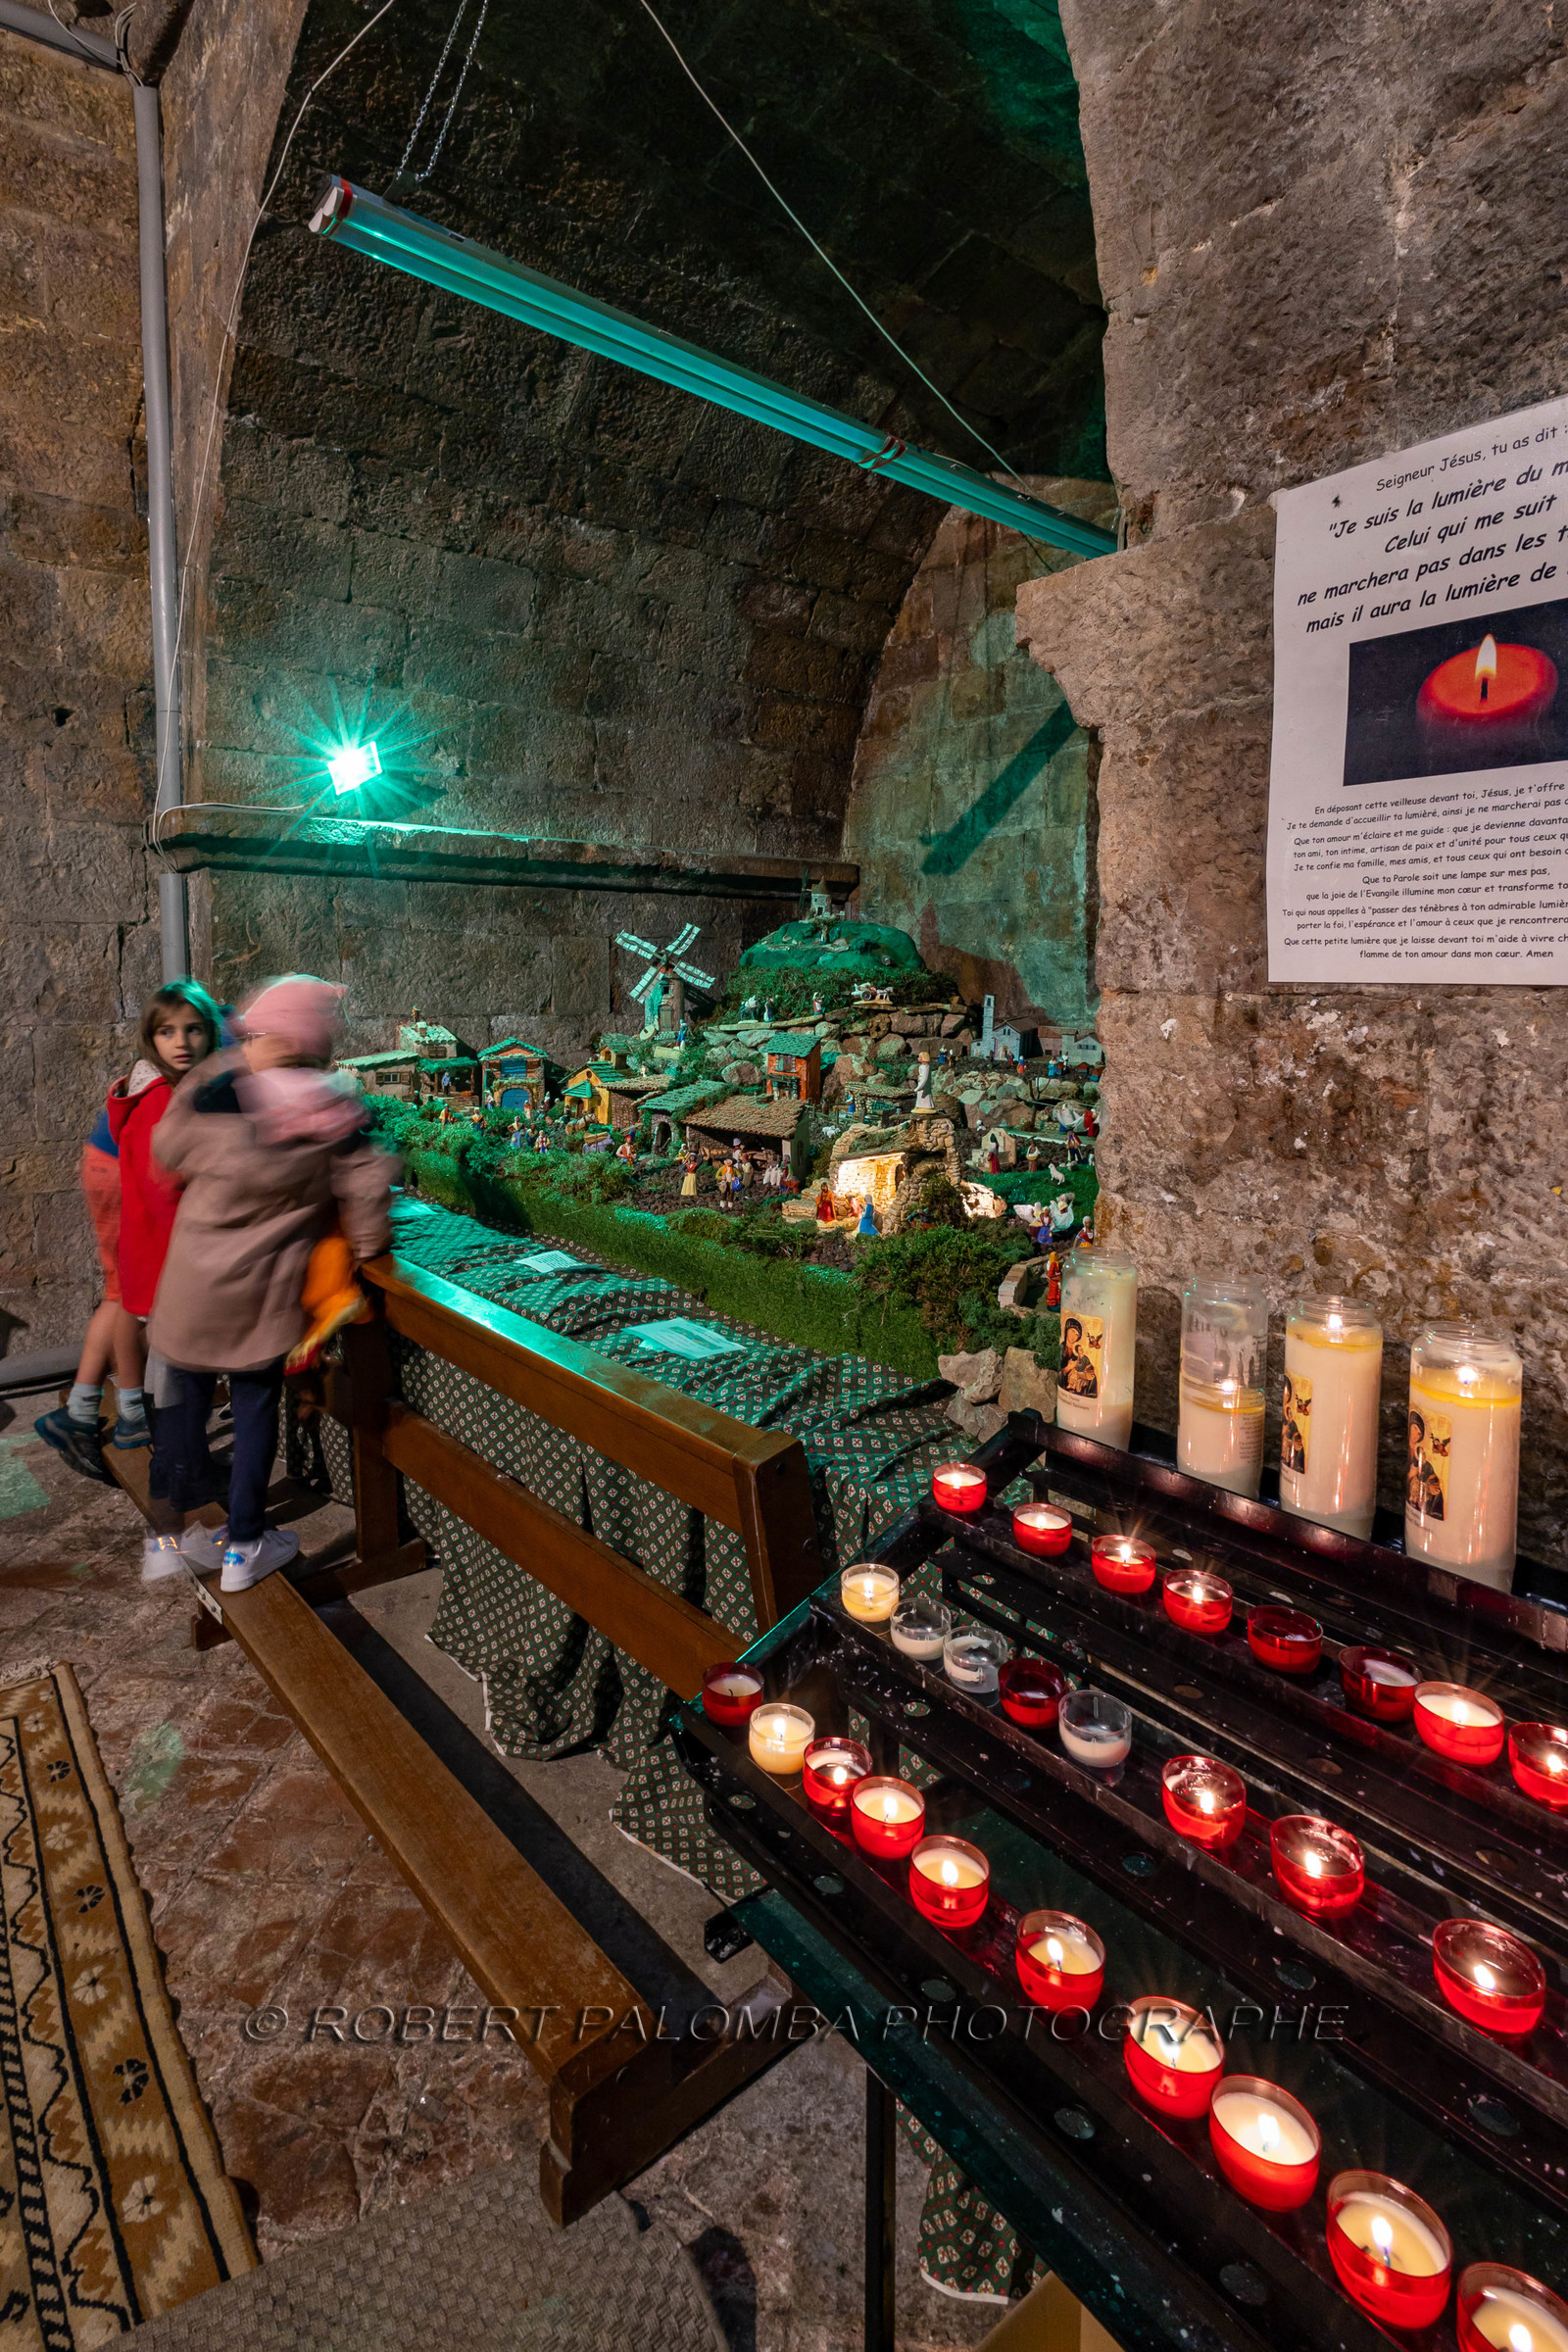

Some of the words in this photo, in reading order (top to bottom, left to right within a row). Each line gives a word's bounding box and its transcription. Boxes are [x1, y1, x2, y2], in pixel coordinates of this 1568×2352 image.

[1376, 465, 1435, 492] Seigneur
[1439, 450, 1487, 472] Jésus,
[1491, 443, 1508, 456] tu
[1512, 435, 1530, 450] as
[1535, 426, 1558, 443] dit
[1329, 519, 1357, 539] "Je
[1363, 507, 1400, 530] suis
[1405, 498, 1424, 517] la
[1431, 477, 1507, 511] lumière
[1515, 464, 1544, 486] du
[1384, 525, 1432, 554] Celui
[1437, 520, 1467, 545] qui
[1474, 511, 1505, 530] me
[1512, 493, 1558, 520] suit
[1297, 591, 1318, 607] ne
[1323, 567, 1410, 600] marchera
[1414, 557, 1451, 582] pas
[1458, 543, 1507, 566] dans
[1514, 532, 1547, 553] les
[1305, 612, 1346, 633] mais
[1351, 604, 1364, 623] il
[1369, 599, 1412, 619] aura
[1419, 589, 1438, 608] la
[1445, 573, 1521, 603] lumière
[1530, 562, 1557, 583] de
[1314, 806, 1325, 815] En
[1326, 803, 1363, 814] déposant
[1364, 801, 1388, 810] cette
[1390, 797, 1427, 808] veilleuse
[1429, 793, 1460, 804] devant
[1462, 792, 1478, 801] toi,
[1481, 788, 1512, 799] Jésus,
[1513, 786, 1525, 798] je
[1527, 782, 1565, 794] t'offre
[1286, 822, 1297, 831] Je
[1308, 817, 1344, 829] demande
[1345, 813, 1392, 825] d'accueillir
[1404, 808, 1440, 820] lumière,
[1442, 808, 1463, 816] ainsi
[1464, 807, 1476, 817] je
[1492, 799, 1542, 812] marcherai
[1544, 799, 1562, 809] pas
[1294, 837, 1310, 847] Que
[1326, 835, 1351, 844] amour
[1352, 831, 1392, 841] m'éclaire
[1393, 829, 1403, 838] et
[1420, 825, 1445, 838] guide
[1451, 825, 1469, 835] que
[1470, 824, 1482, 834] je
[1483, 820, 1526, 831] devienne
[1369, 845, 1400, 854] artisan
[1401, 842, 1413, 852] de
[1414, 842, 1434, 853] paix
[1436, 840, 1446, 849] et
[1448, 836, 1482, 848] d'unité
[1484, 837, 1506, 848] pour
[1508, 835, 1531, 844] tous
[1533, 833, 1557, 842] ceux
[1294, 863, 1304, 872] Je
[1316, 860, 1342, 870] confie
[1356, 858, 1388, 868] famille,
[1389, 858, 1407, 866] mes
[1408, 856, 1431, 865] amis,
[1433, 855, 1444, 863] et
[1468, 853, 1491, 861] ceux
[1493, 850, 1507, 861] qui
[1509, 850, 1527, 858] ont
[1529, 847, 1562, 858] besoin
[1361, 875, 1380, 886] Que
[1393, 873, 1421, 883] Parole
[1422, 872, 1440, 881] soit
[1460, 870, 1488, 881] lampe
[1507, 868, 1528, 877] mes
[1530, 867, 1550, 878] pas,
[1321, 891, 1329, 900] la
[1330, 892, 1347, 902] joie
[1348, 890, 1358, 899] de
[1360, 888, 1400, 900] l'Evangile
[1401, 887, 1435, 897] illumine
[1484, 884, 1495, 893] et
[1497, 881, 1554, 892] transforme
[1282, 908, 1294, 917] Toi
[1327, 906, 1359, 917] appelles
[1360, 906, 1366, 914] à
[1367, 906, 1399, 916] "passer
[1401, 905, 1417, 913] des
[1419, 903, 1460, 913] ténèbres
[1461, 902, 1468, 911] à
[1488, 900, 1537, 910] admirable
[1297, 922, 1322, 931] porter
[1323, 920, 1331, 929] la
[1332, 920, 1347, 930] foi,
[1348, 919, 1396, 930] l'espérance
[1397, 919, 1407, 928] et
[1409, 918, 1444, 927] l'amour
[1445, 917, 1451, 926] à
[1477, 918, 1494, 928] que
[1495, 916, 1506, 928] je
[1283, 937, 1299, 947] Que
[1324, 938, 1348, 947] petite
[1350, 936, 1381, 945] lumière
[1382, 938, 1397, 947] que
[1398, 938, 1409, 947] je
[1410, 935, 1436, 945] laisse
[1438, 935, 1469, 944] devant
[1471, 935, 1484, 944] toi
[1486, 934, 1519, 944] m'aide
[1521, 933, 1528, 943] à
[1530, 934, 1555, 943] vivre
[1359, 950, 1390, 958] flamme
[1391, 950, 1402, 958] de
[1450, 949, 1472, 958] dans
[1525, 950, 1554, 958] Amen
